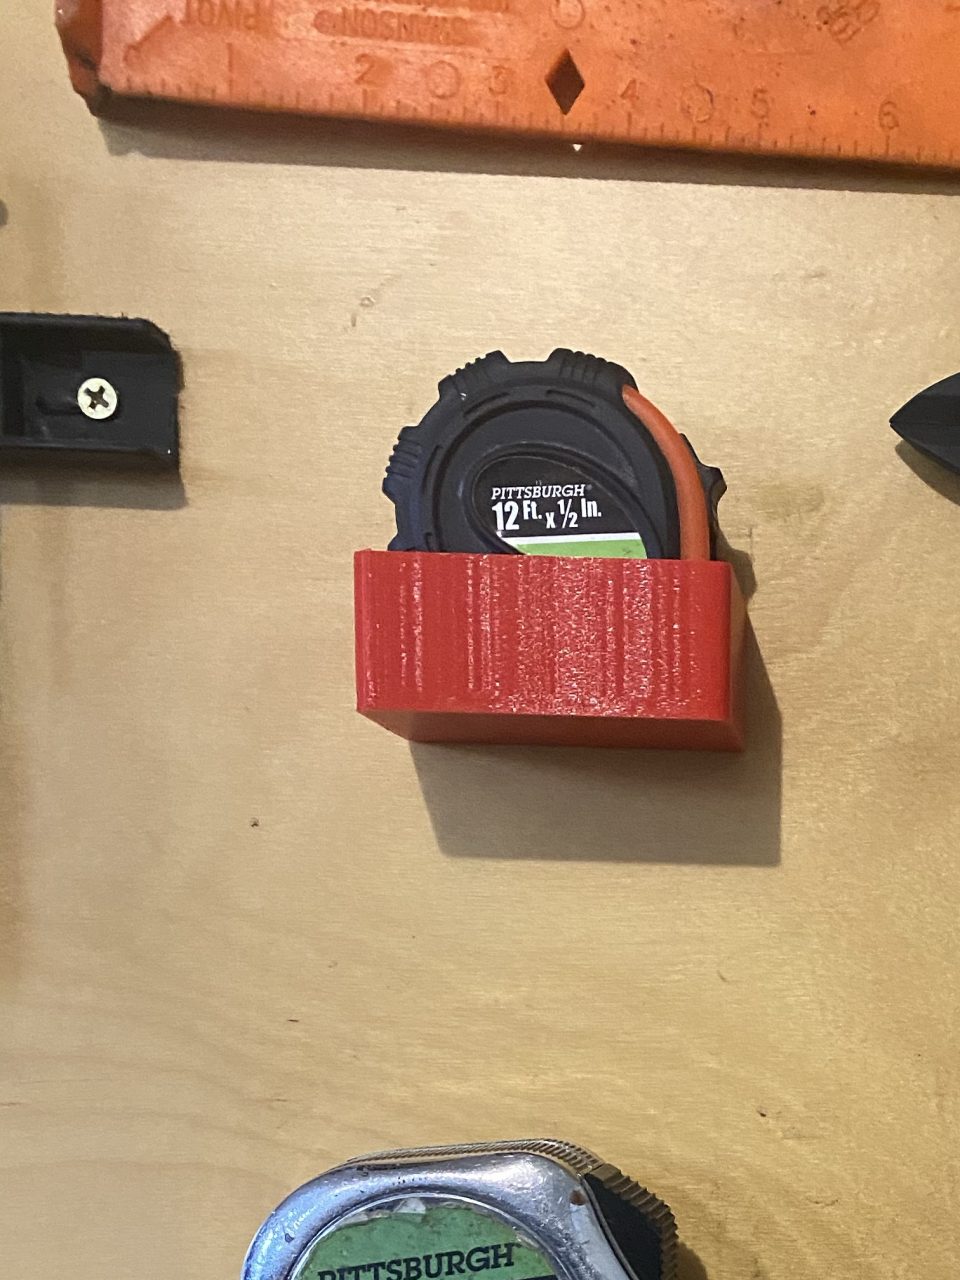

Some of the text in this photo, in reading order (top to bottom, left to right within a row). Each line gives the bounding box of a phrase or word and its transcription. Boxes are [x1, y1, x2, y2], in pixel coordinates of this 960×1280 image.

[879, 101, 899, 130] 6
[491, 484, 586, 500] PITTSBURGH
[491, 501, 520, 530] 12
[522, 500, 543, 520] Ft.
[545, 512, 556, 529] x
[580, 498, 602, 518] In.
